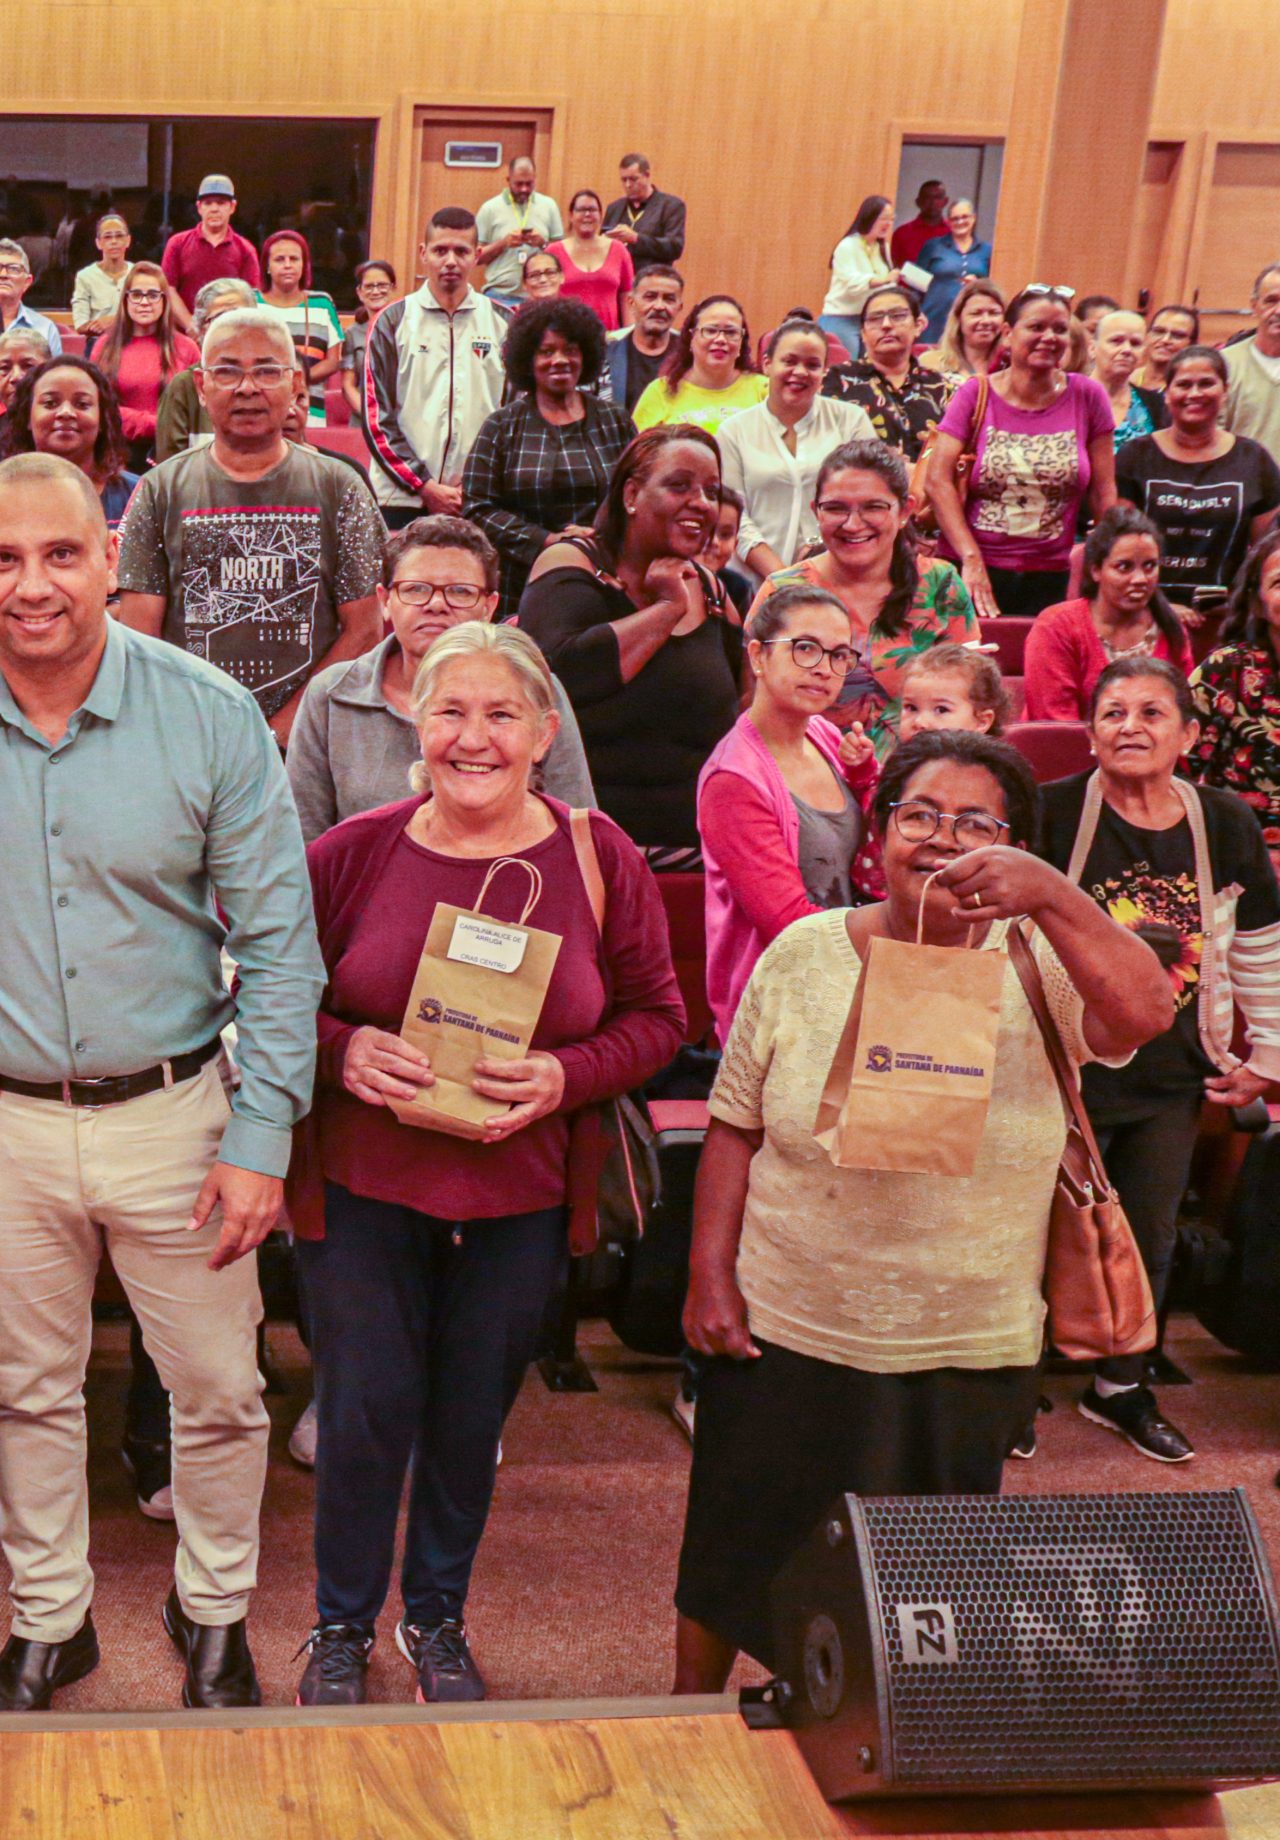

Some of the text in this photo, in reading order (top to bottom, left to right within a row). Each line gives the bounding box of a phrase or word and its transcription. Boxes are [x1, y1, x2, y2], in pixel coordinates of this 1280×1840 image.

[252, 512, 318, 524] DIVISION
[221, 556, 283, 580] NORTH
[1160, 556, 1208, 568] ERIOUS
[221, 580, 283, 591] WESTERN
[459, 922, 492, 936] CAROLINA
[513, 936, 522, 944] DE
[460, 953, 507, 970] CRAS CENTRO
[443, 1014, 520, 1045] SANTANA DE PARNAÍBA
[896, 1052, 926, 1061] PREFEITURA
[895, 1060, 984, 1077] SANTANA DE PARNAÍBA
[913, 1609, 946, 1656] FZ
